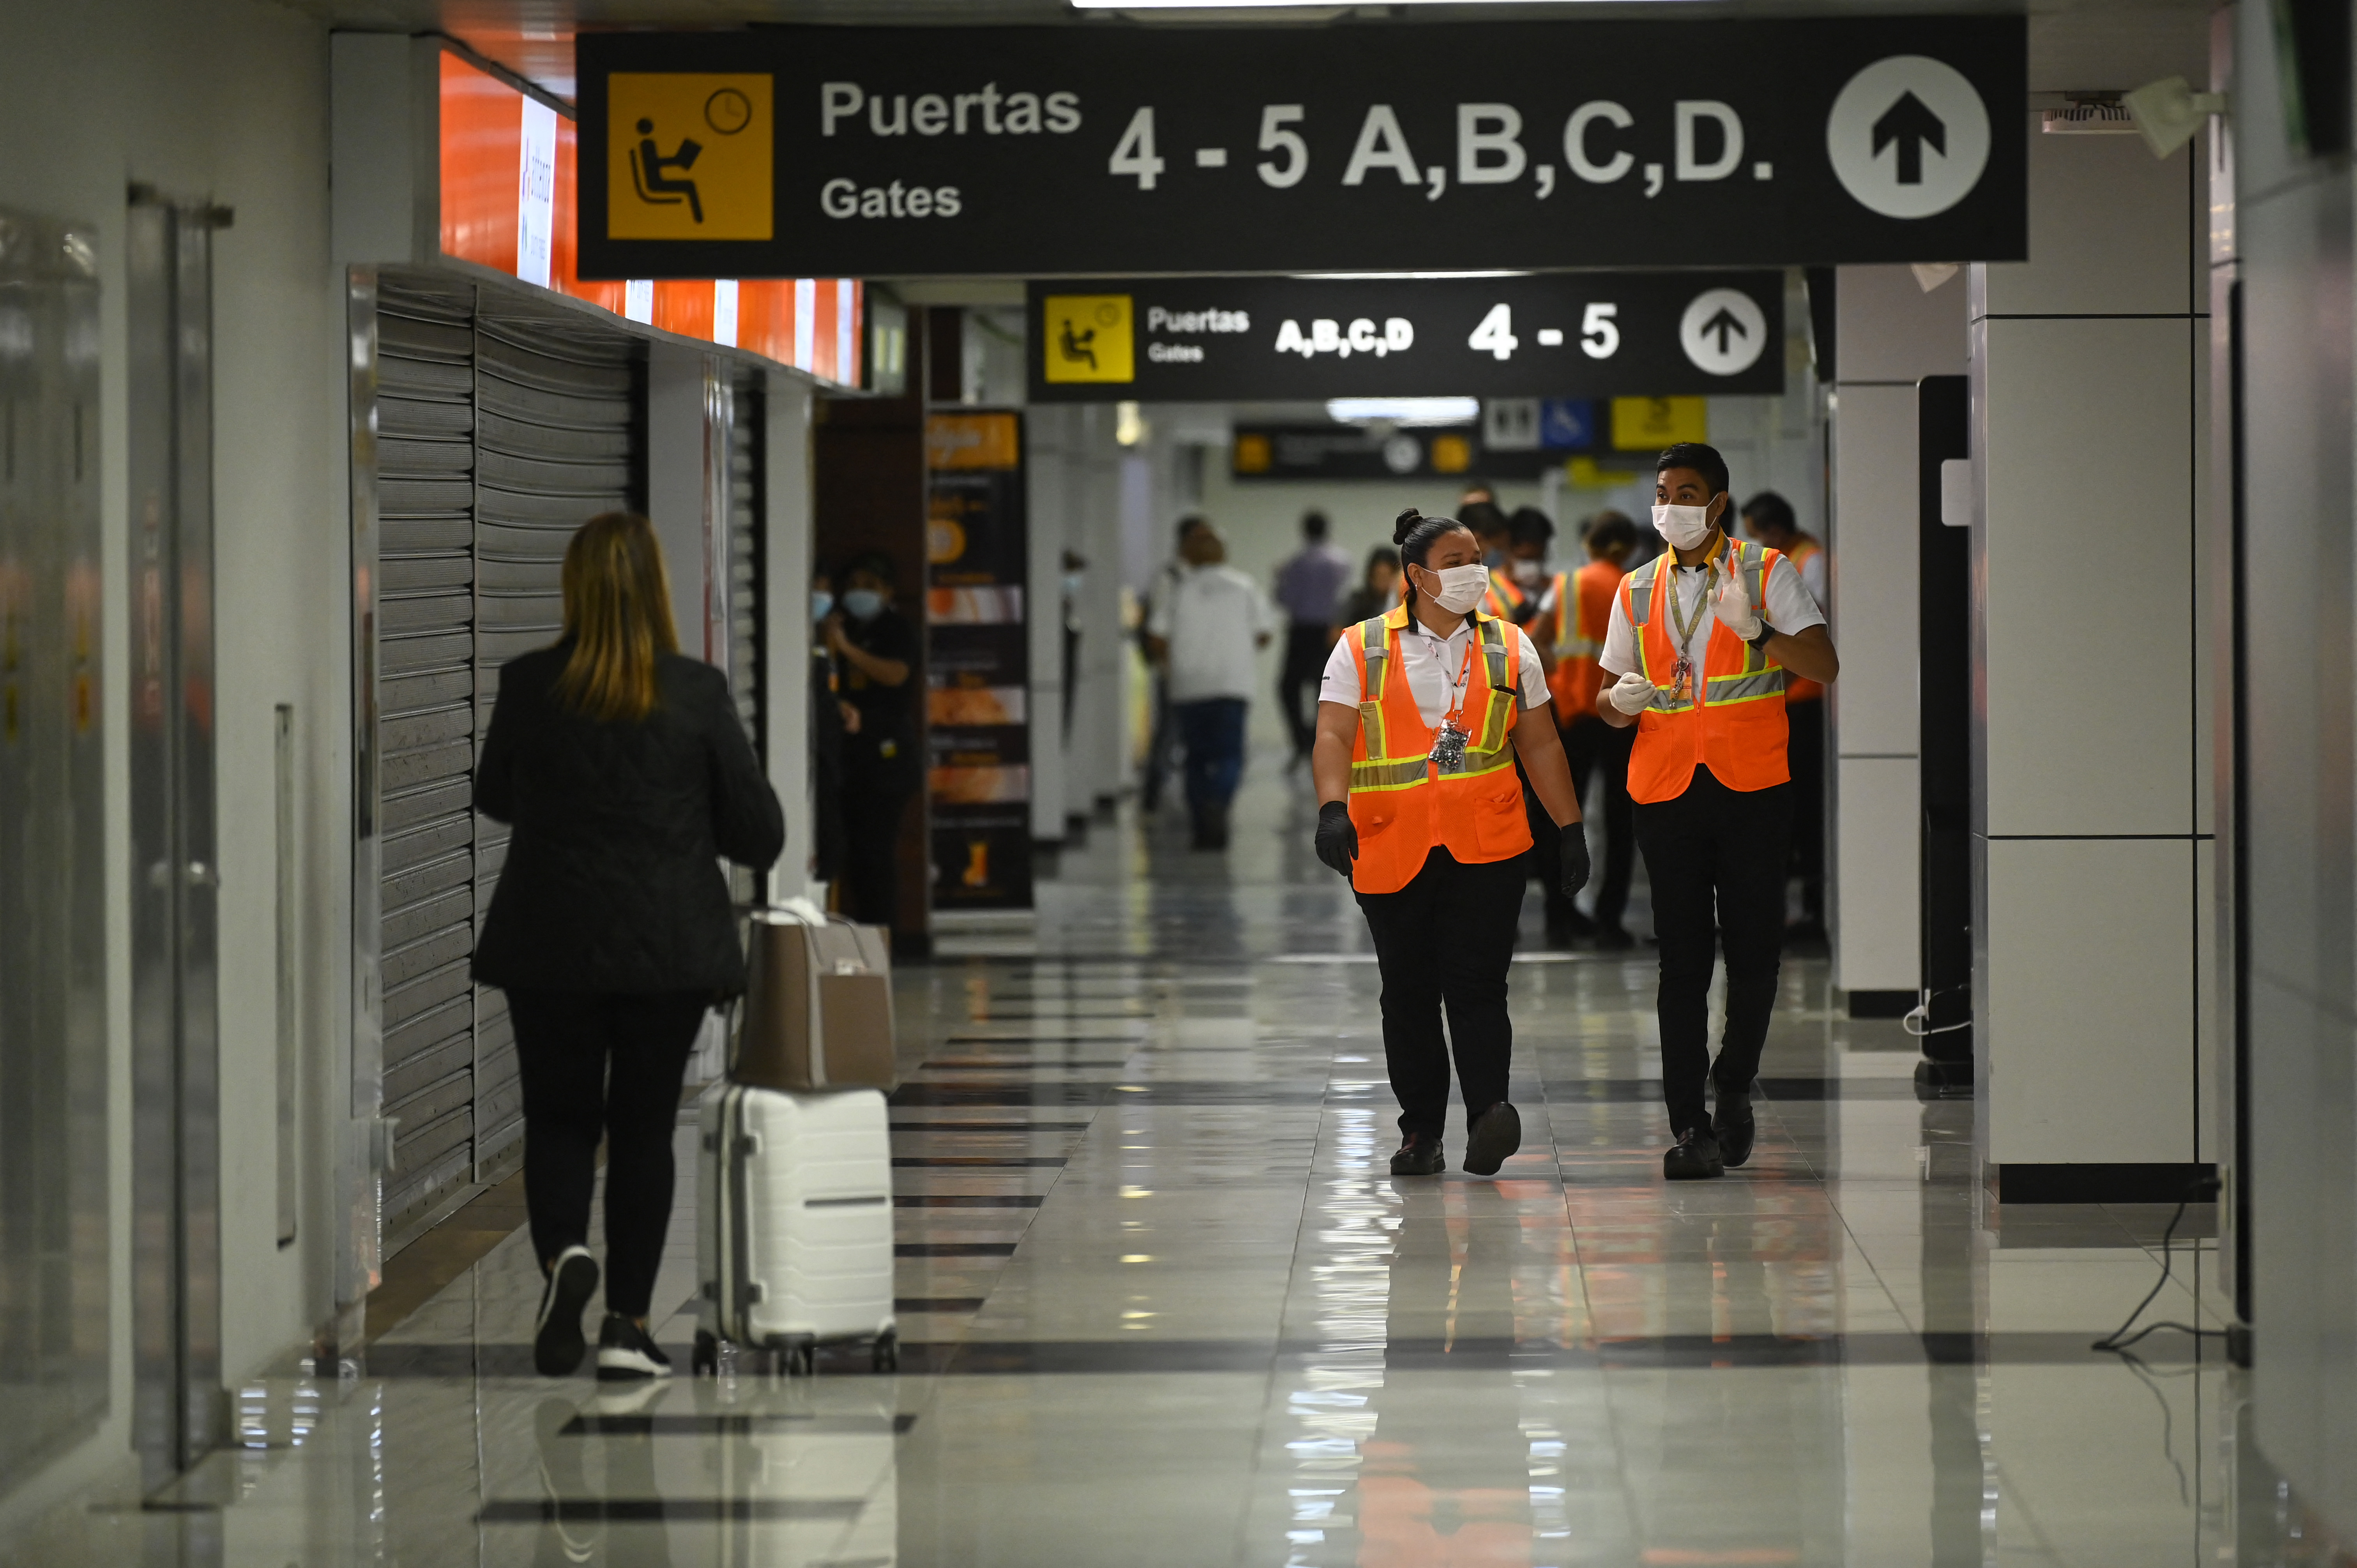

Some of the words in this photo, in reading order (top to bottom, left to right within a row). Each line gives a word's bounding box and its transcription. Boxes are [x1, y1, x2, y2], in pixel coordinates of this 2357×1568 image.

[822, 82, 1082, 137] Puertas
[1109, 106, 1165, 190] 4
[1196, 148, 1227, 168] -
[1256, 104, 1308, 189] 5
[1341, 100, 1773, 201] A,B,C,D.
[821, 178, 962, 219] Gates
[1148, 307, 1250, 333] Puertas
[1275, 317, 1414, 359] A,B,C,D
[1468, 303, 1519, 361] 4
[1537, 328, 1564, 346] -
[1580, 302, 1620, 359] 5
[1148, 342, 1204, 362] Gates
[1670, 586, 1678, 607] PALMA
[1687, 615, 1700, 635] PALMA
